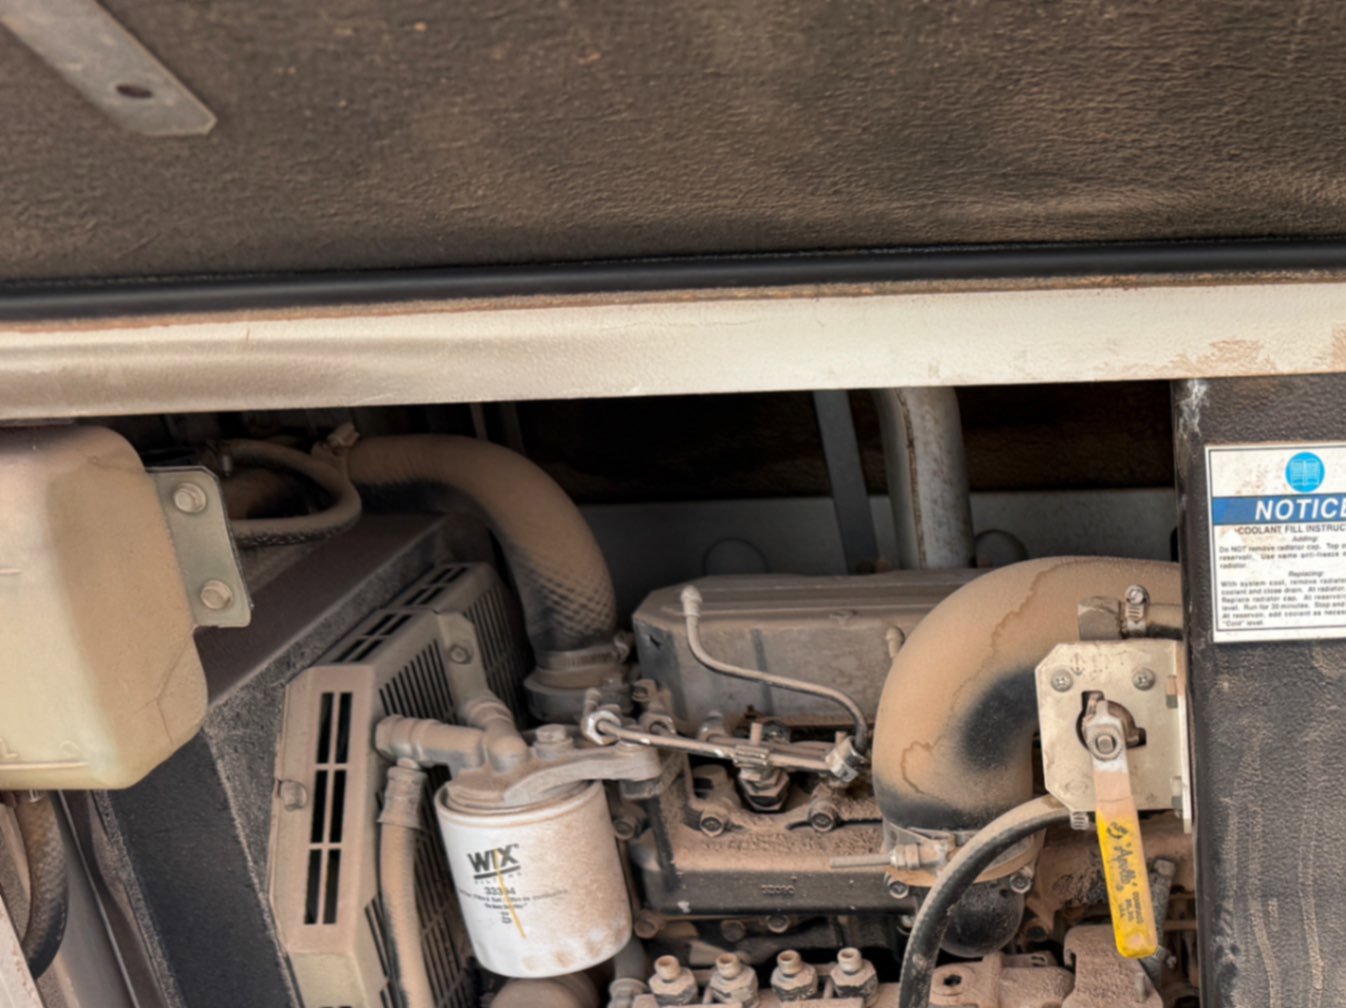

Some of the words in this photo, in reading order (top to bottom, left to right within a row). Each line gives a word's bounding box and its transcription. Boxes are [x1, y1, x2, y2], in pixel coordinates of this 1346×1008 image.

[1237, 526, 1282, 535] COOLANT
[1284, 525, 1303, 534] FILL
[1326, 542, 1340, 551] Top
[1240, 580, 1266, 588] system
[467, 845, 518, 873] WIX
